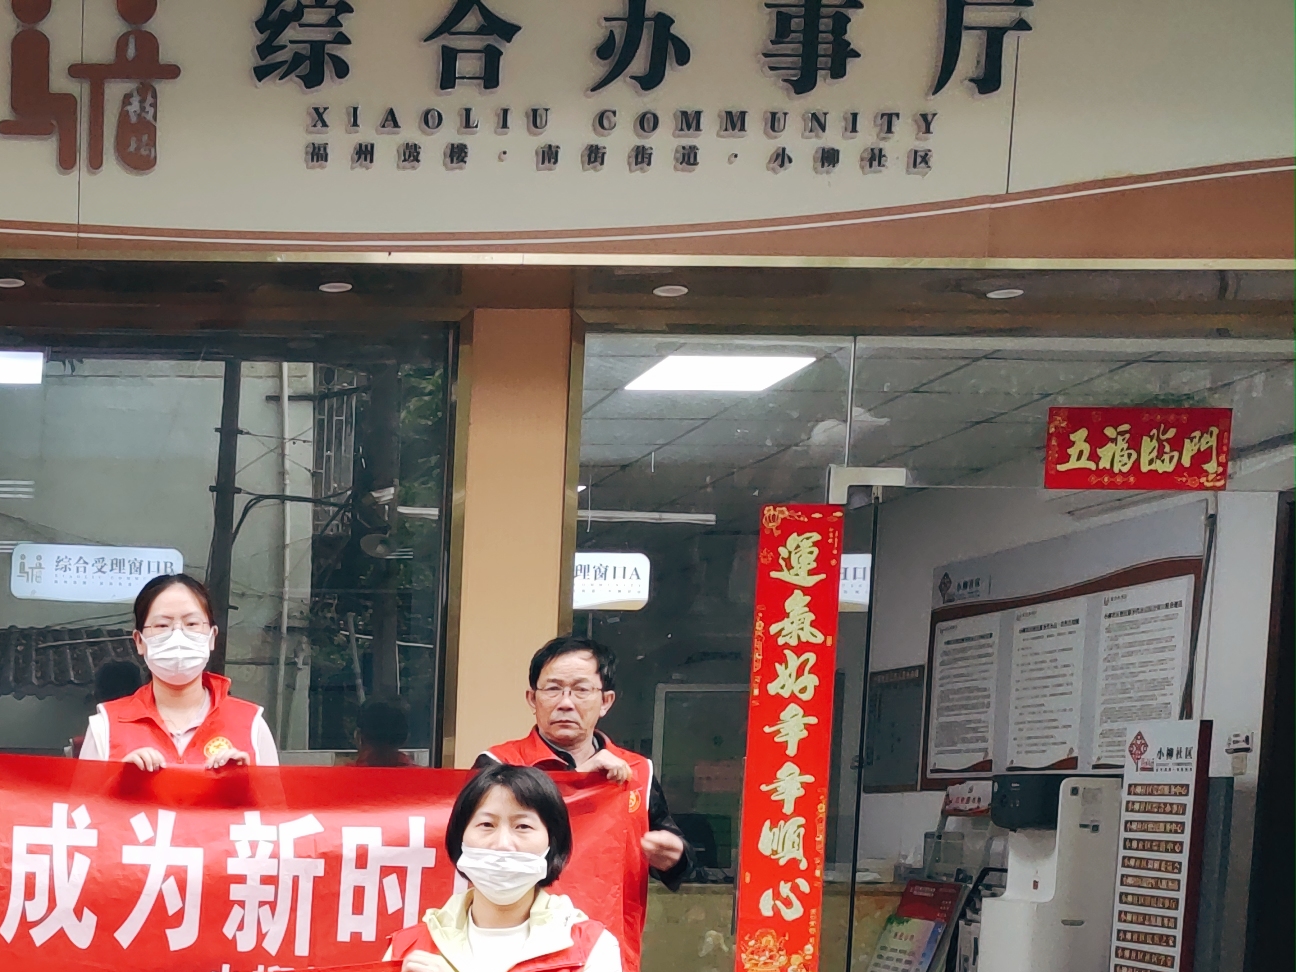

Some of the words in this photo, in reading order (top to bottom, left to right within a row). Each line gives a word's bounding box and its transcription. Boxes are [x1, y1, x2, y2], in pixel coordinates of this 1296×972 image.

[253, 0, 1034, 98] 综合办事厅
[310, 106, 551, 131] XIAOLIU
[598, 109, 938, 135] COMMUNITY
[54, 555, 174, 576] 综合受理窗口B
